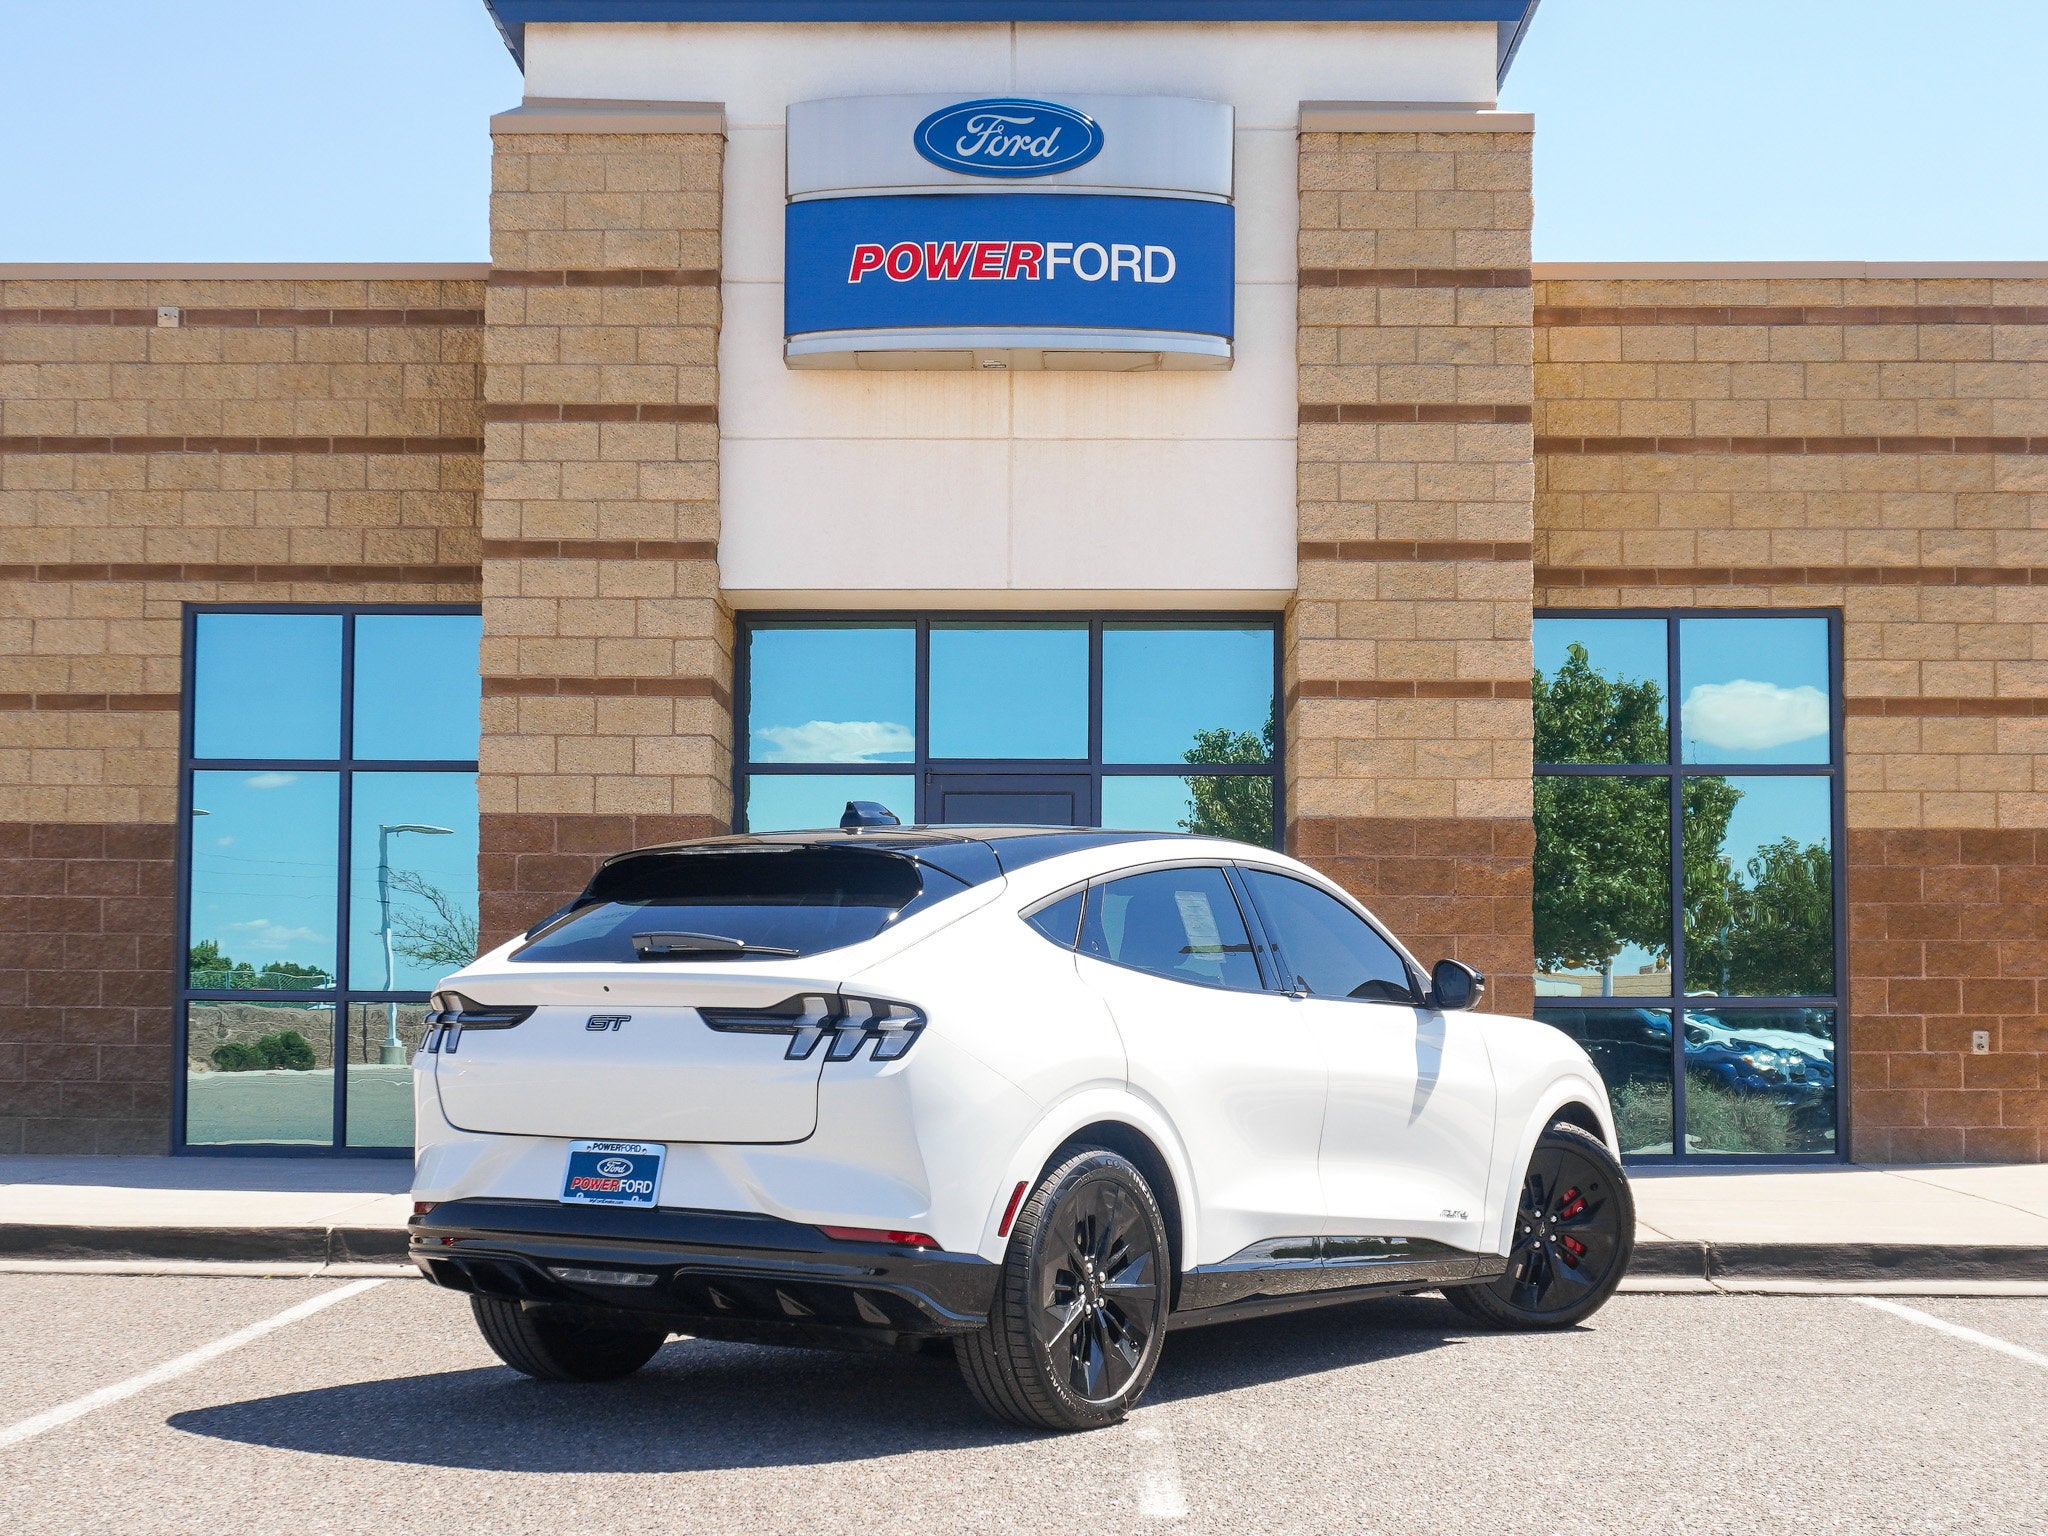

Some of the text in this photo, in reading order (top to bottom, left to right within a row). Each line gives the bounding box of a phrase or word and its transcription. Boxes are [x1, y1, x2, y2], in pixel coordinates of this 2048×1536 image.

[956, 114, 1060, 158] Ford
[585, 1014, 632, 1031] GT
[603, 1160, 625, 1174] Ford
